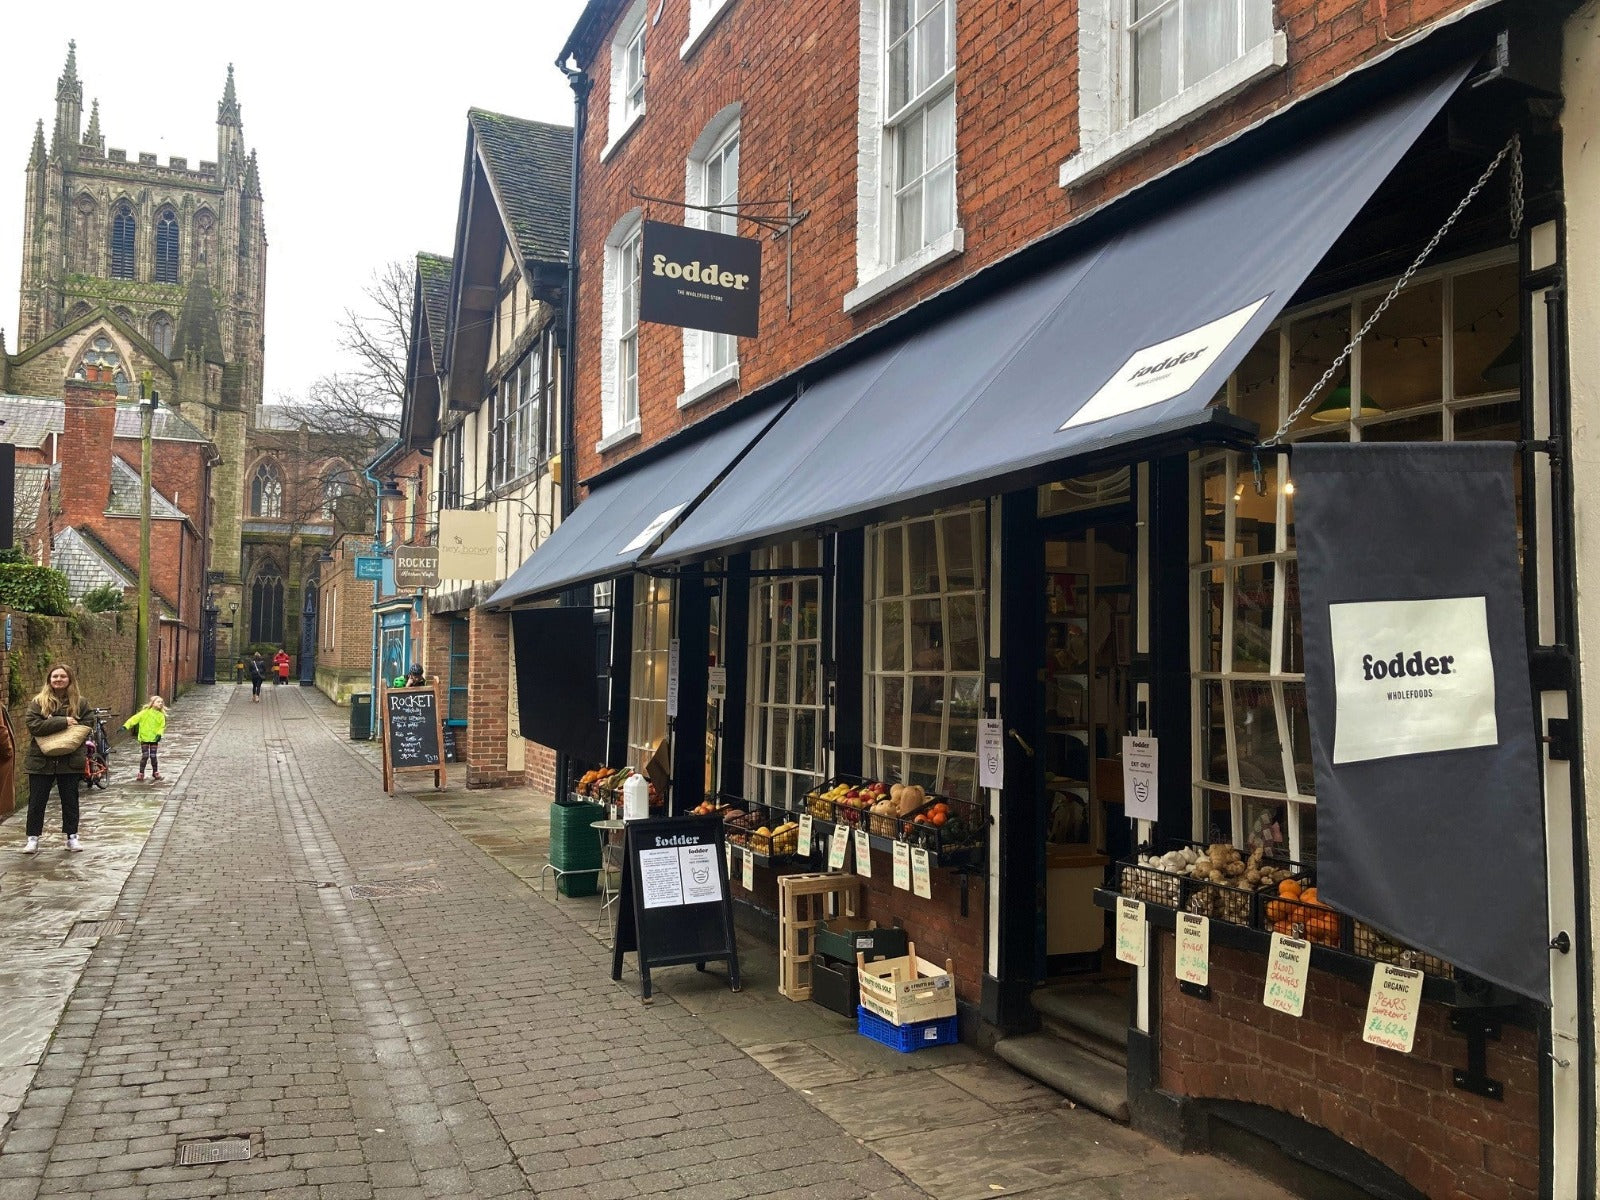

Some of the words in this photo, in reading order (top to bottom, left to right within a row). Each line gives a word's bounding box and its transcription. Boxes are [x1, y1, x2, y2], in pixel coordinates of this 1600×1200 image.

[652, 254, 750, 290] fodder
[1127, 346, 1209, 383] fodder
[398, 557, 438, 569] ROCKET
[1362, 651, 1455, 681] fodder
[1386, 688, 1434, 701] WHOLEFOODS
[390, 694, 434, 711] ROCKET
[1132, 740, 1150, 749] fodder
[655, 834, 700, 846] fodder
[1183, 928, 1201, 937] ORGANIC
[1278, 950, 1300, 964] ORGANIC
[1273, 960, 1295, 976] BLOOD
[1383, 980, 1411, 994] ORGANIC
